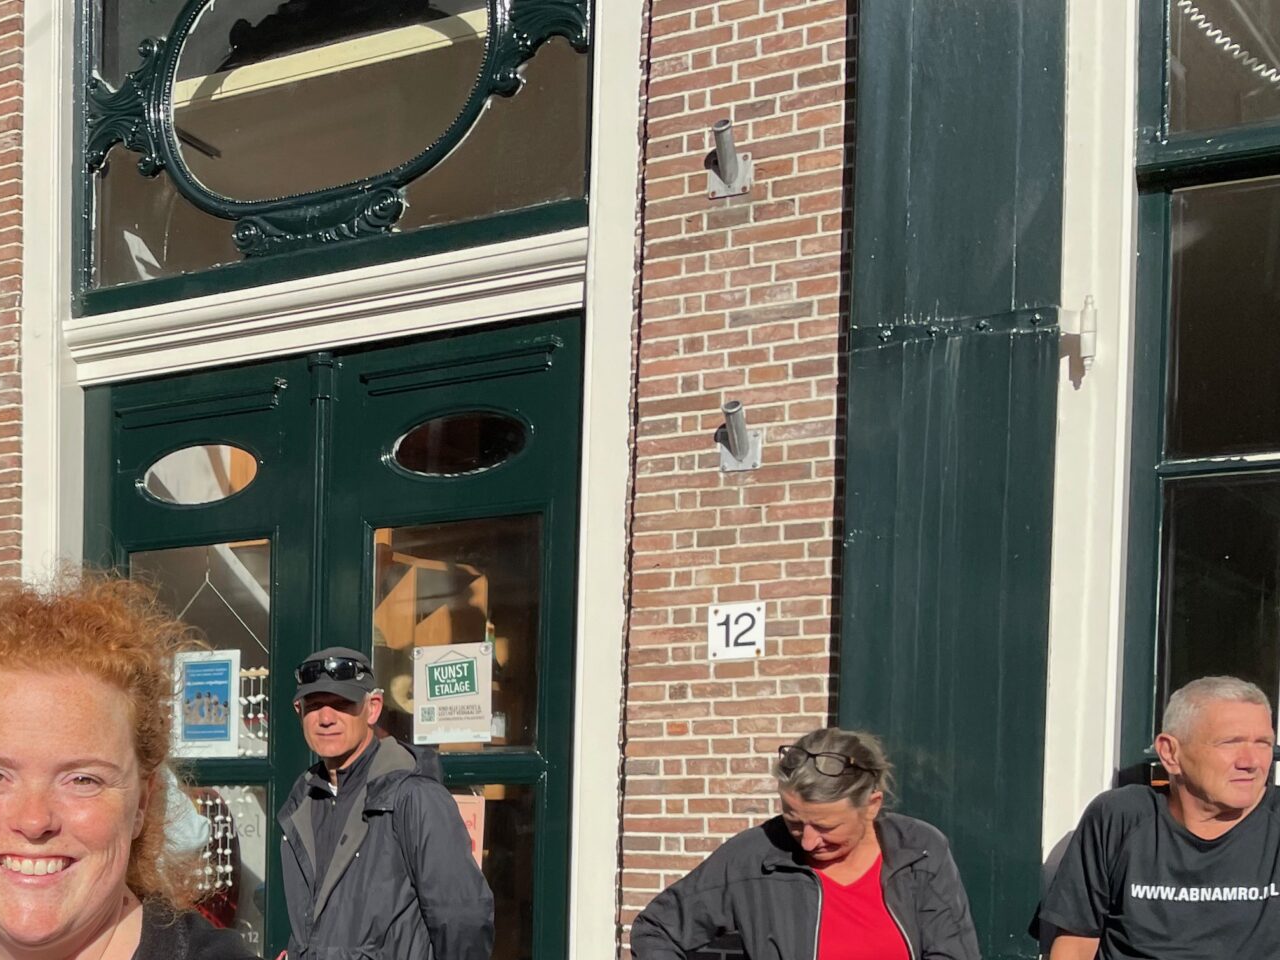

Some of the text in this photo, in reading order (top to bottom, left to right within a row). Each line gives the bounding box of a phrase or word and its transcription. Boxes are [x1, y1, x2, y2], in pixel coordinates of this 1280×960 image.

[716, 611, 756, 648] 12
[433, 662, 469, 683] KUNST
[434, 680, 471, 696] ETALAGE
[247, 931, 259, 943] 12
